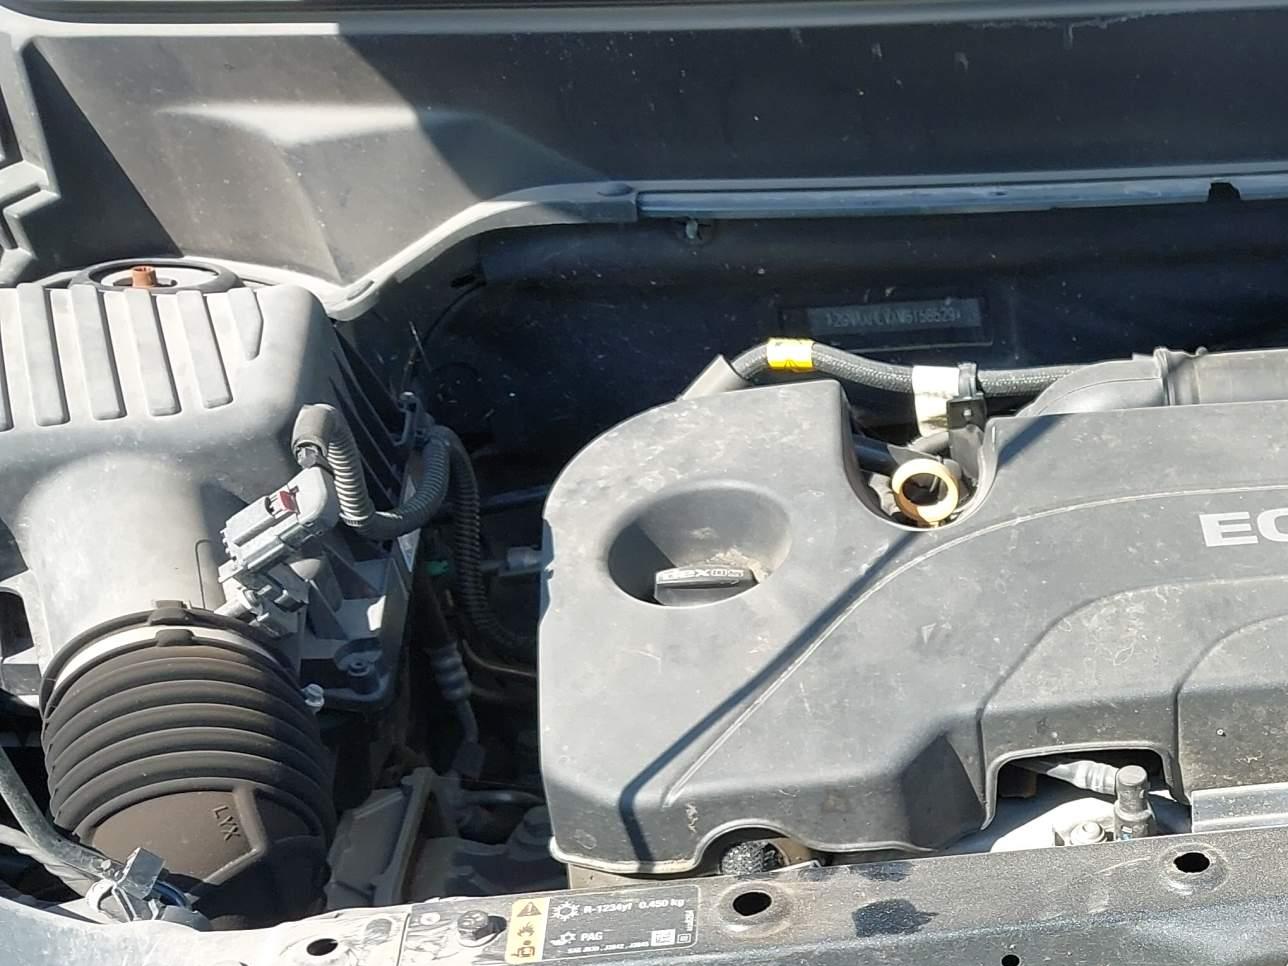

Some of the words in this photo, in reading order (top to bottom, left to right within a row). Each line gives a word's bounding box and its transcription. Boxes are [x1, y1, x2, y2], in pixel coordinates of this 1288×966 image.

[583, 901, 633, 914] R-1234yf
[670, 897, 685, 909] kg
[580, 931, 604, 942] PAG
